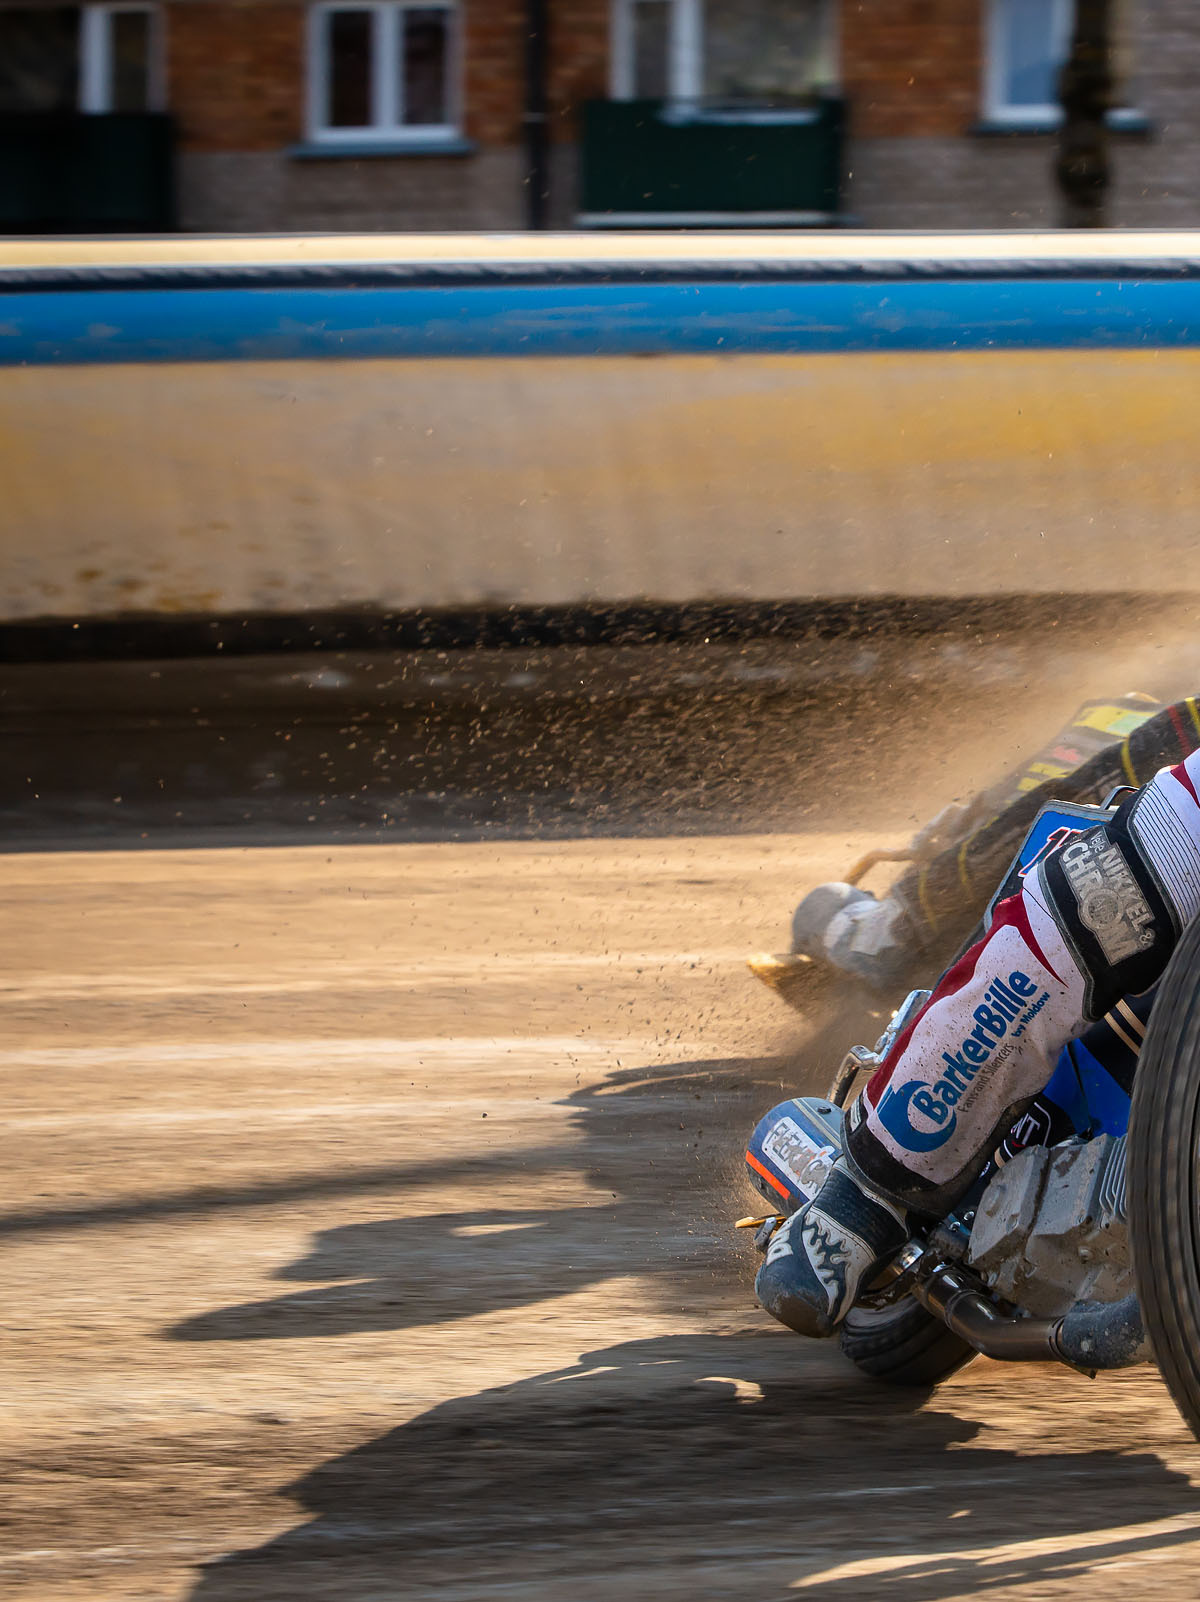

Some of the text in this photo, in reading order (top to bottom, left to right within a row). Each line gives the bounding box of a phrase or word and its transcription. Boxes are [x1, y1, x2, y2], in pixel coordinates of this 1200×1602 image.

[1062, 842, 1138, 956] CHROM
[1098, 848, 1152, 932] NIKKEL
[912, 971, 1037, 1125] BarkerBille
[1011, 992, 1051, 1038] by Moldow
[984, 1043, 1016, 1077] Silencers
